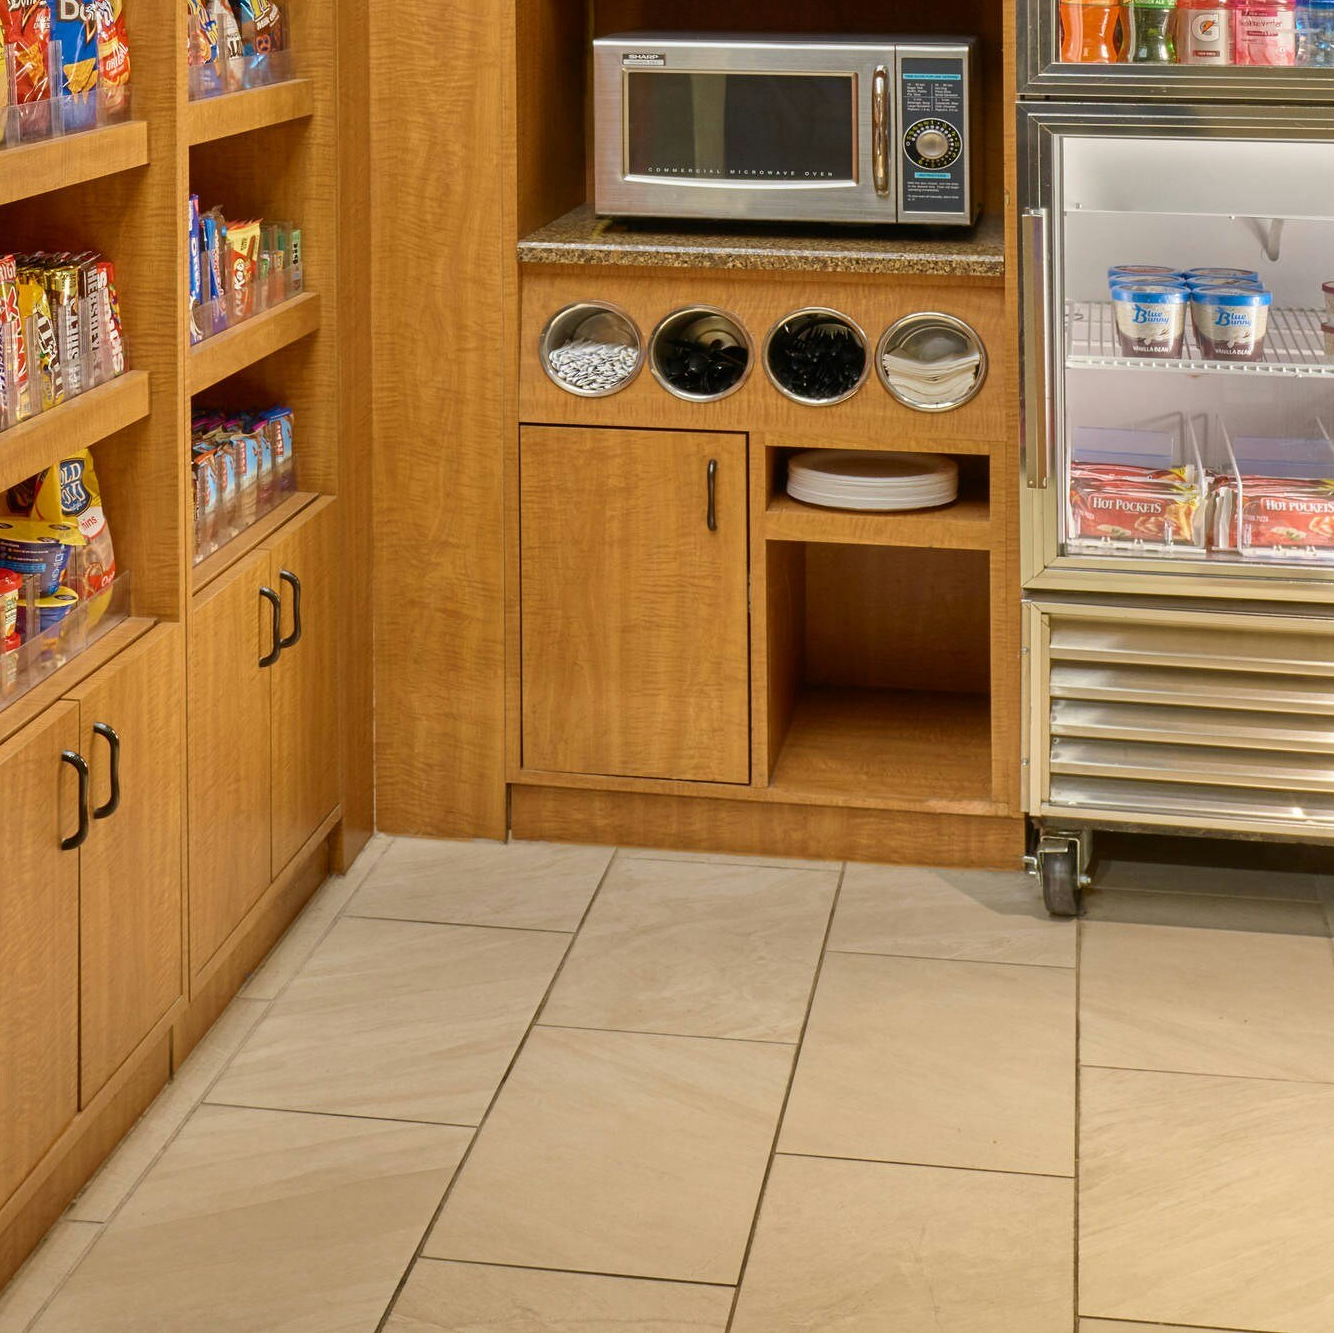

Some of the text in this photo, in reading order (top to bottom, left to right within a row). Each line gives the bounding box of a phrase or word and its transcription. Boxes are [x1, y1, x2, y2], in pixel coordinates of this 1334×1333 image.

[1093, 497, 1162, 513] HOT POCKETS
[1266, 500, 1286, 512] HOT
